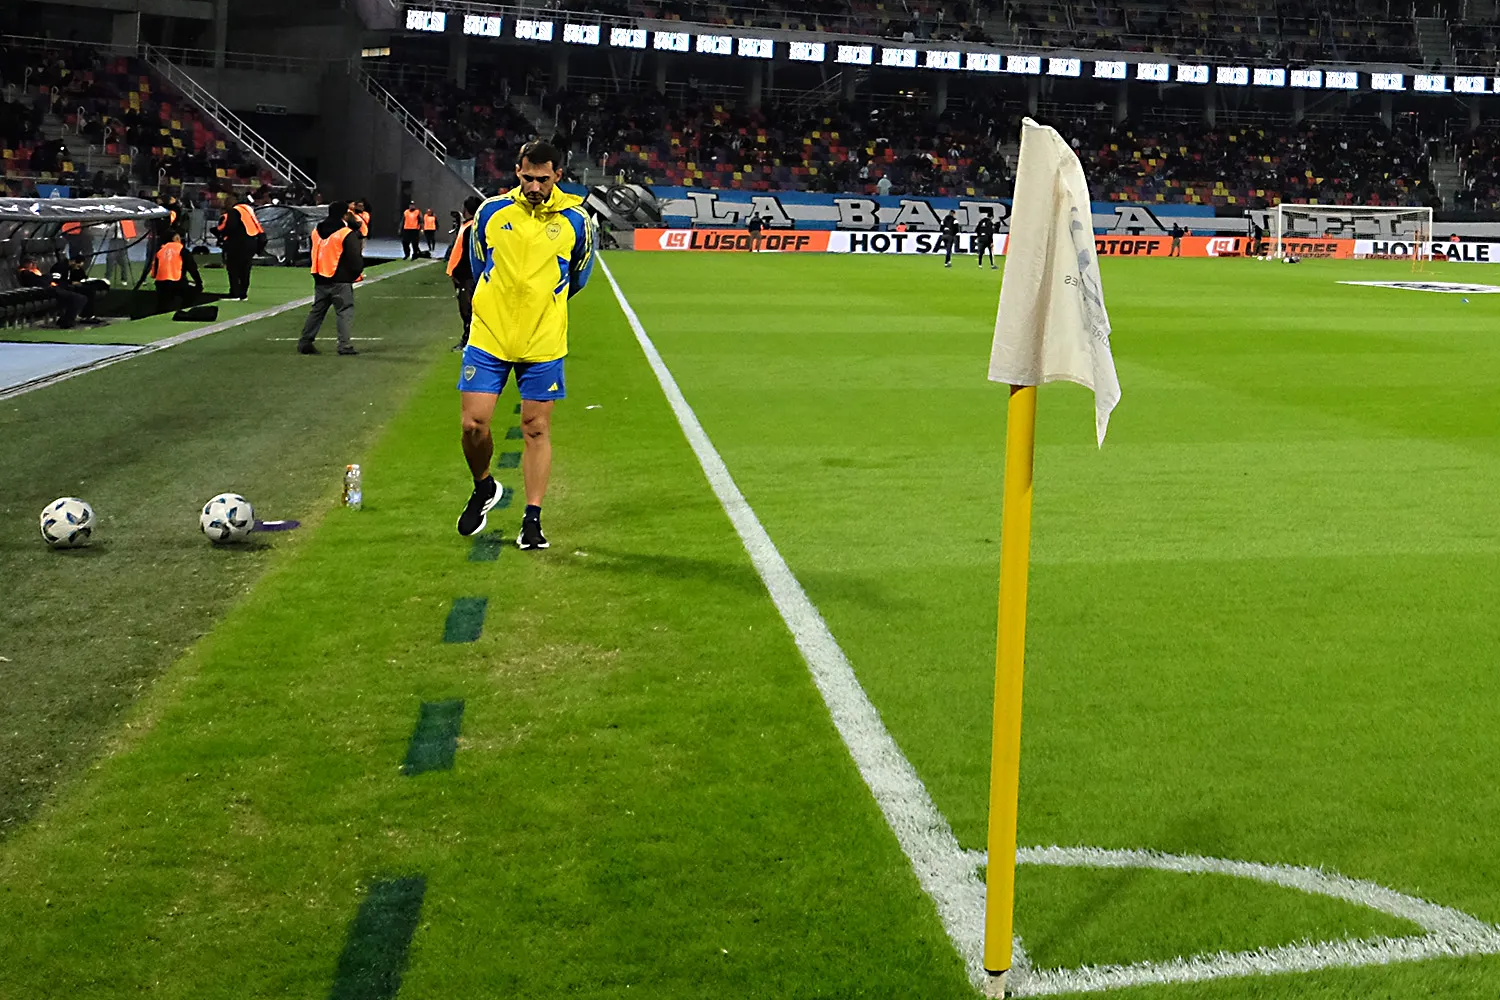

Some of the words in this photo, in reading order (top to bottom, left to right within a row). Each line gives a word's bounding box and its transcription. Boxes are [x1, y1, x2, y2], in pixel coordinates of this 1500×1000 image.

[687, 191, 795, 229] LA
[834, 198, 1171, 236] BARA
[850, 233, 908, 253] HOT
[1372, 241, 1424, 258] HOT
[1431, 243, 1490, 262] SALE
